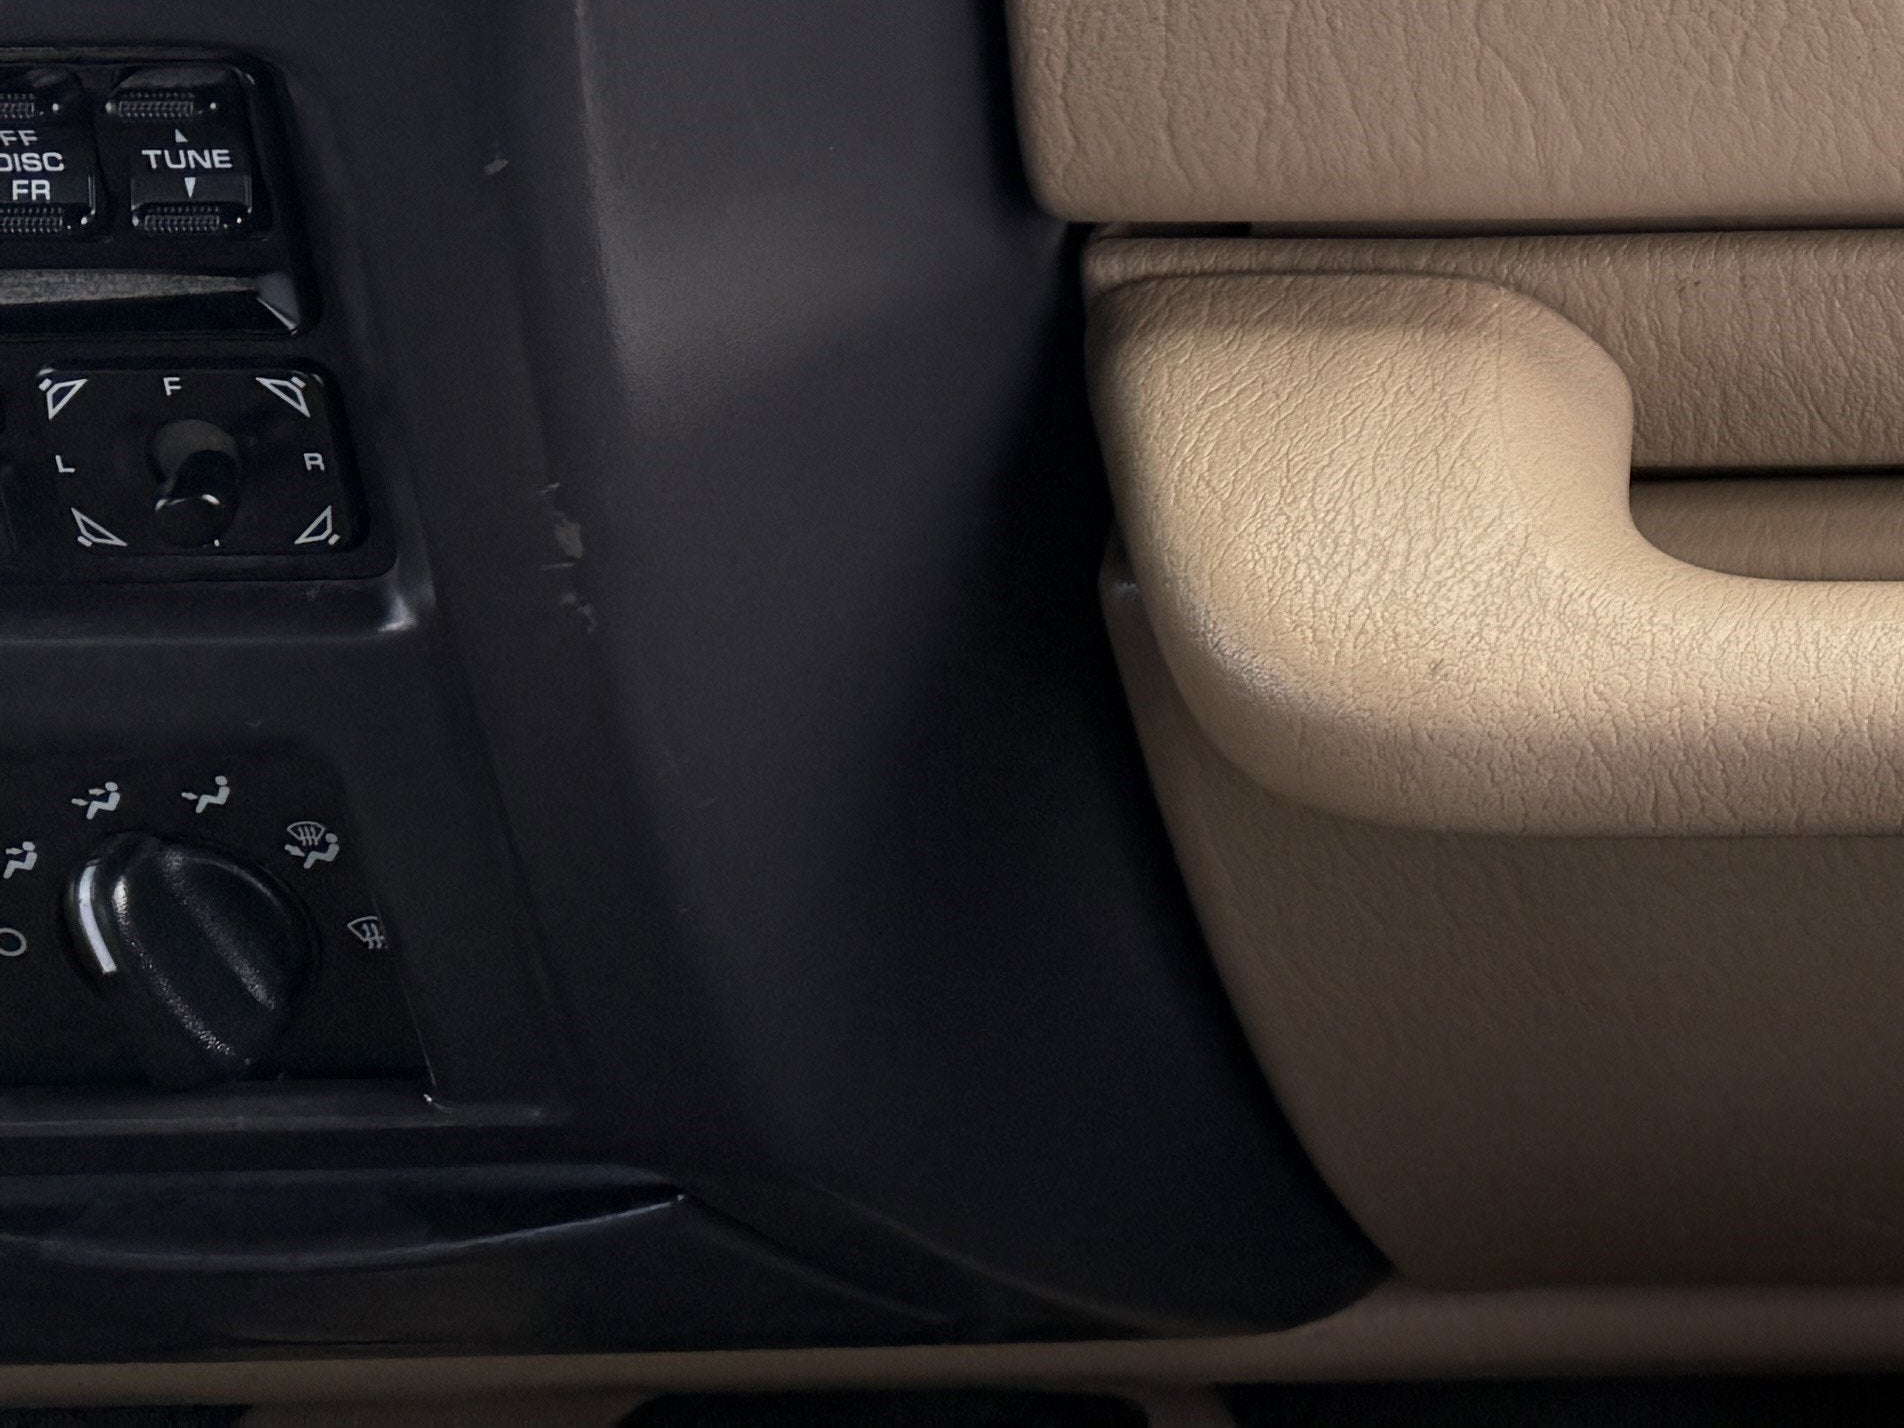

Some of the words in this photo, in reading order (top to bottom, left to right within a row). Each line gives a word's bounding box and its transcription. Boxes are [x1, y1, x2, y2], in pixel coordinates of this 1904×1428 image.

[0, 152, 65, 172] DISC
[141, 148, 233, 170] TUNE
[12, 179, 51, 201] FR
[163, 377, 182, 396] F
[55, 454, 75, 474] L
[303, 452, 325, 471] R
